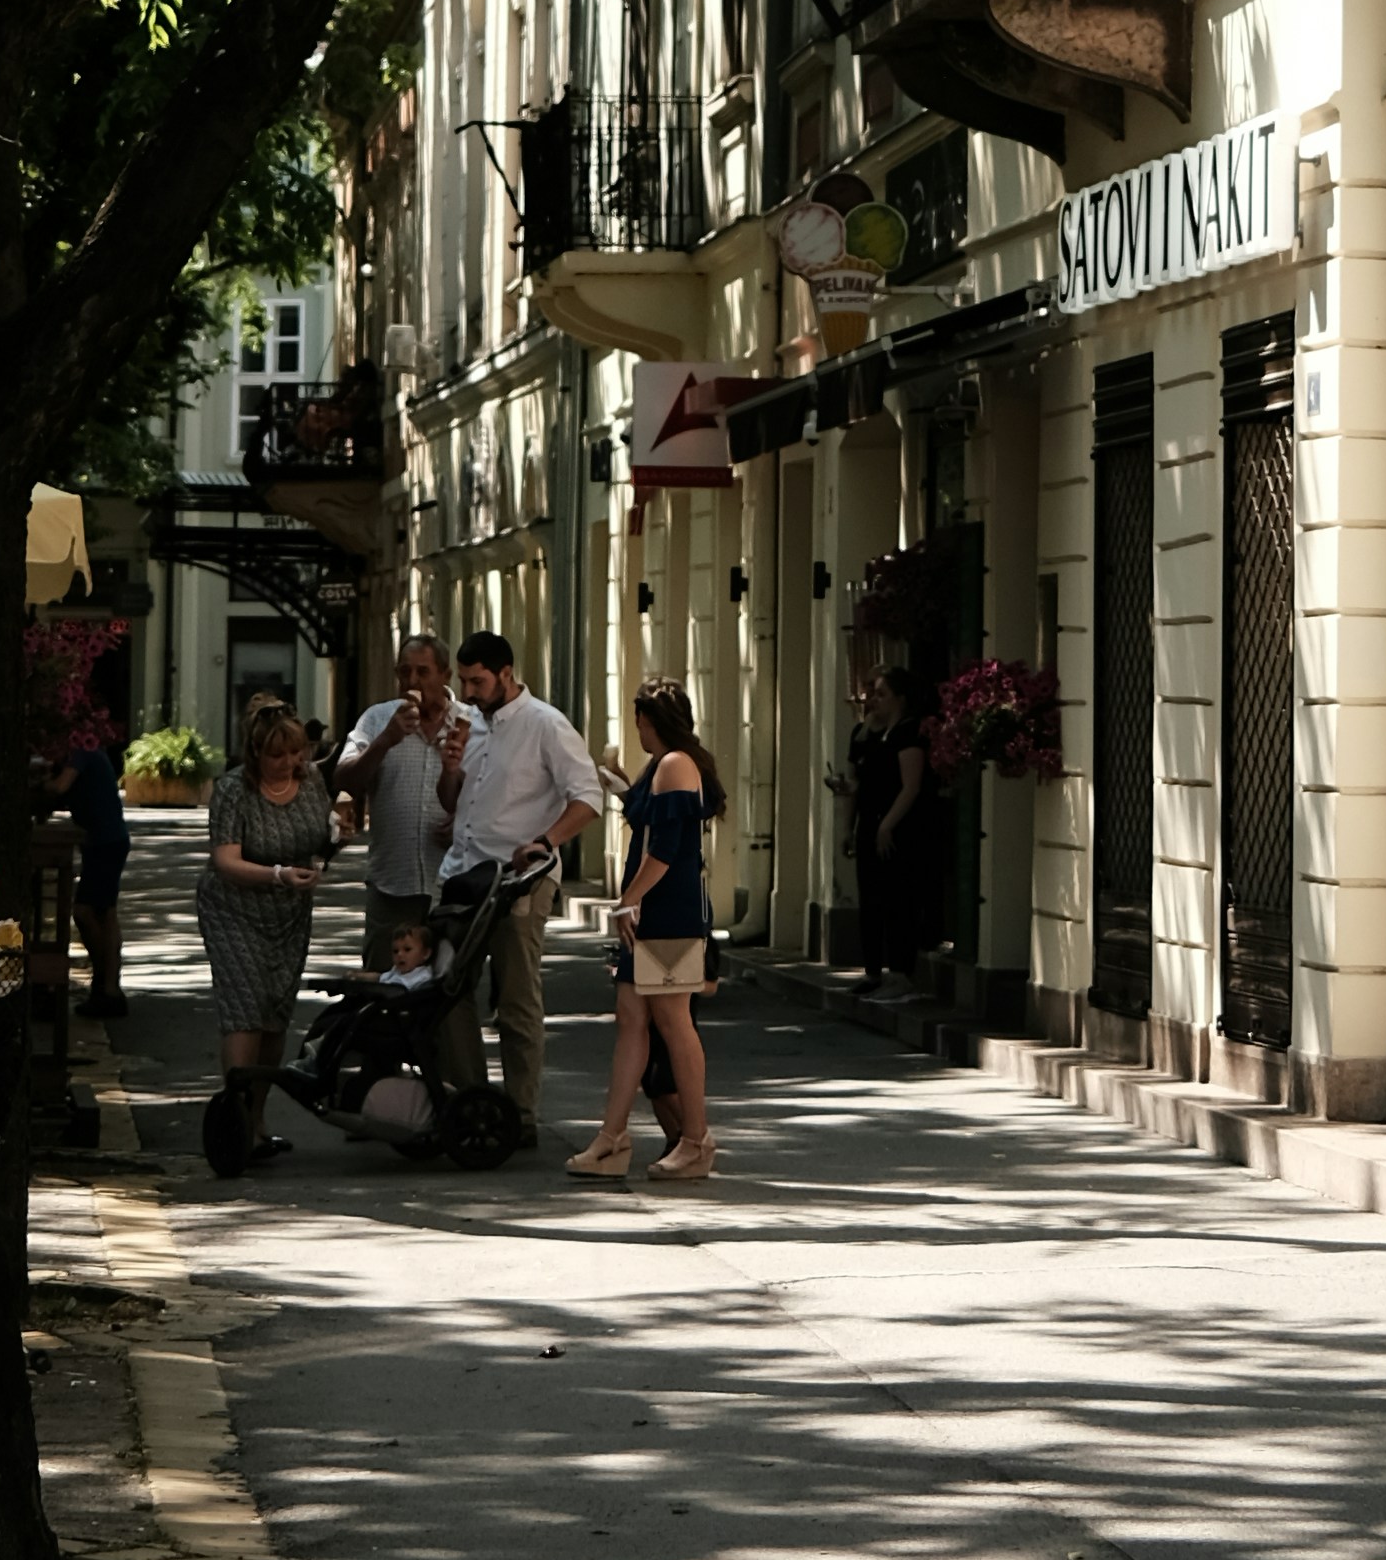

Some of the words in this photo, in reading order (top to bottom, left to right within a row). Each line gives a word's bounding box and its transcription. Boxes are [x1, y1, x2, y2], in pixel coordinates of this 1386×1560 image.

[1061, 169, 1152, 304] SATOVI
[1181, 120, 1276, 268] NAKIT
[317, 589, 357, 600] COSTA
